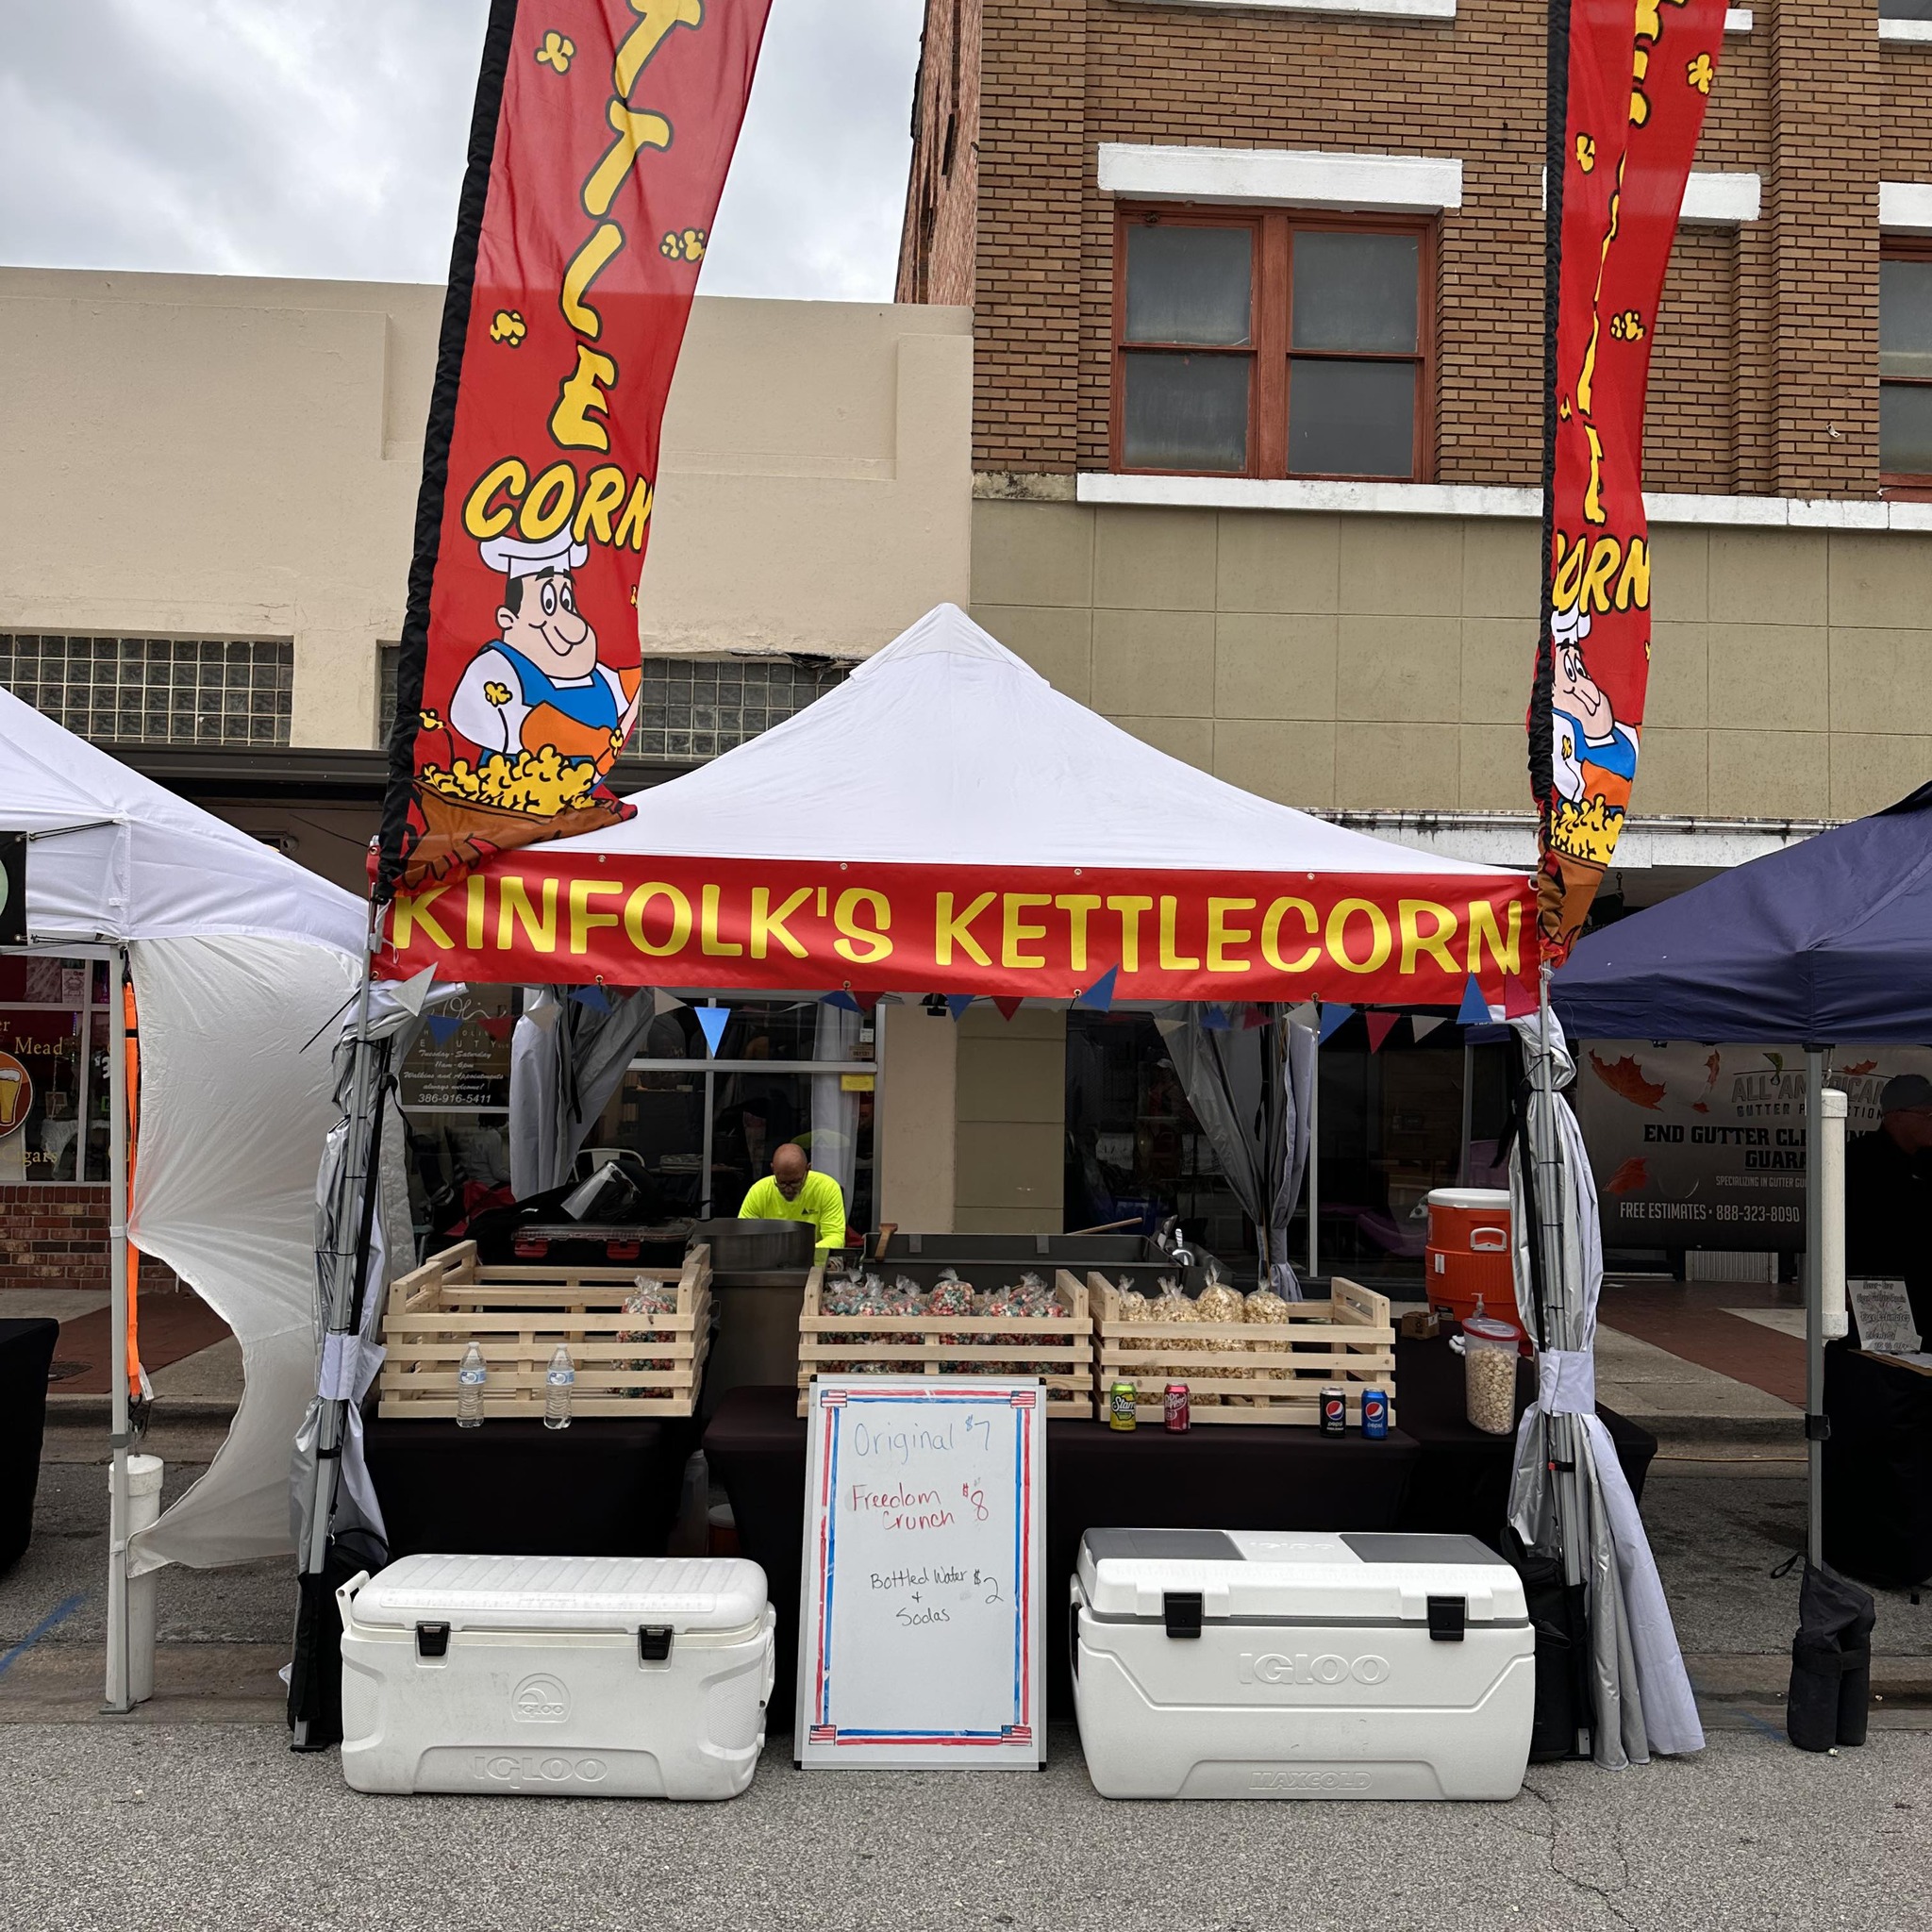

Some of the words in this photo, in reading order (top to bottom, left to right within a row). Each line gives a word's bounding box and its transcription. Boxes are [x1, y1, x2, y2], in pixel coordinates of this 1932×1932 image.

[460, 455, 655, 555] CORN
[391, 873, 894, 965] KINFOLK'S
[934, 890, 1524, 977] KETTLECORN
[14, 1036, 64, 1056] Mead
[403, 1071, 435, 1080] Walkins
[453, 1073, 505, 1081] Appointments
[423, 1082, 449, 1091] always
[451, 1082, 485, 1091] welcome!
[417, 1092, 492, 1104] 386-916-5411
[1731, 1074, 1773, 1103] ALL
[1777, 1074, 1886, 1106] AMRICAN
[1737, 1103, 1790, 1118] GUTTER
[1643, 1124, 1685, 1143] END
[1690, 1125, 1770, 1146] GUTTER
[1715, 1174, 1759, 1189] SPECIALIZING
[1760, 1176, 1768, 1188] IN
[1768, 1176, 1794, 1189] GUTTER
[1620, 1202, 1646, 1220] FREE
[1648, 1203, 1707, 1222] ESTIMATES
[1715, 1204, 1801, 1224] 888-323-8090
[854, 1422, 955, 1465] Original
[851, 1481, 942, 1513] Freedom
[881, 1508, 956, 1531] Crunch
[870, 1568, 930, 1591] Bottled
[932, 1568, 969, 1586] Water
[894, 1607, 952, 1627] Sodas
[1238, 1651, 1391, 1686] IGLOO
[517, 1702, 565, 1719] IGLOO
[474, 1754, 609, 1790] IGLOO
[1247, 1770, 1374, 1791] MAXCOLD
